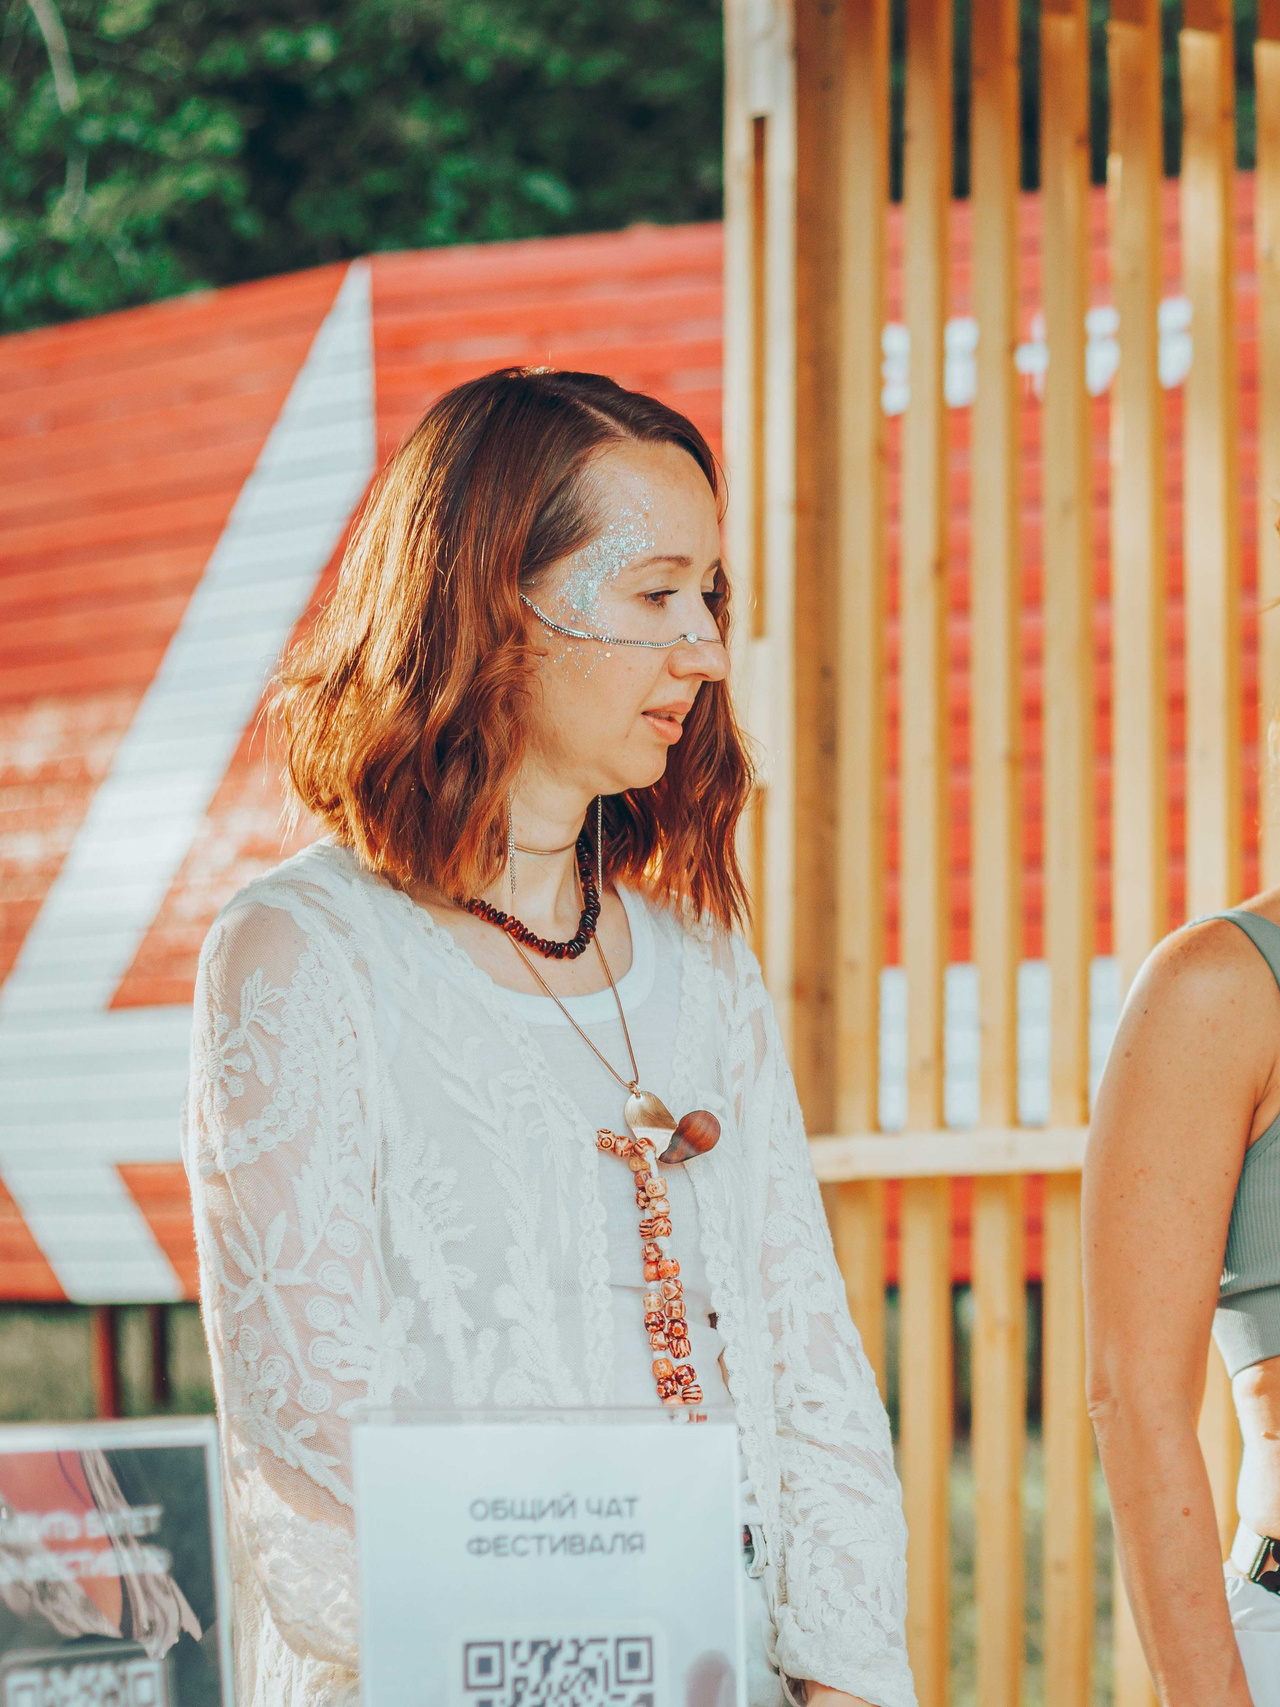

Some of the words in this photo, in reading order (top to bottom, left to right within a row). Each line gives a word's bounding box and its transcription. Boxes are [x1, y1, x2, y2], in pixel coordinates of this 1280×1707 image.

[469, 1492, 577, 1522] ОБЩИЙ
[585, 1496, 640, 1519] ЧАТ
[466, 1532, 647, 1558] ФЕСТИВАЛЯ
